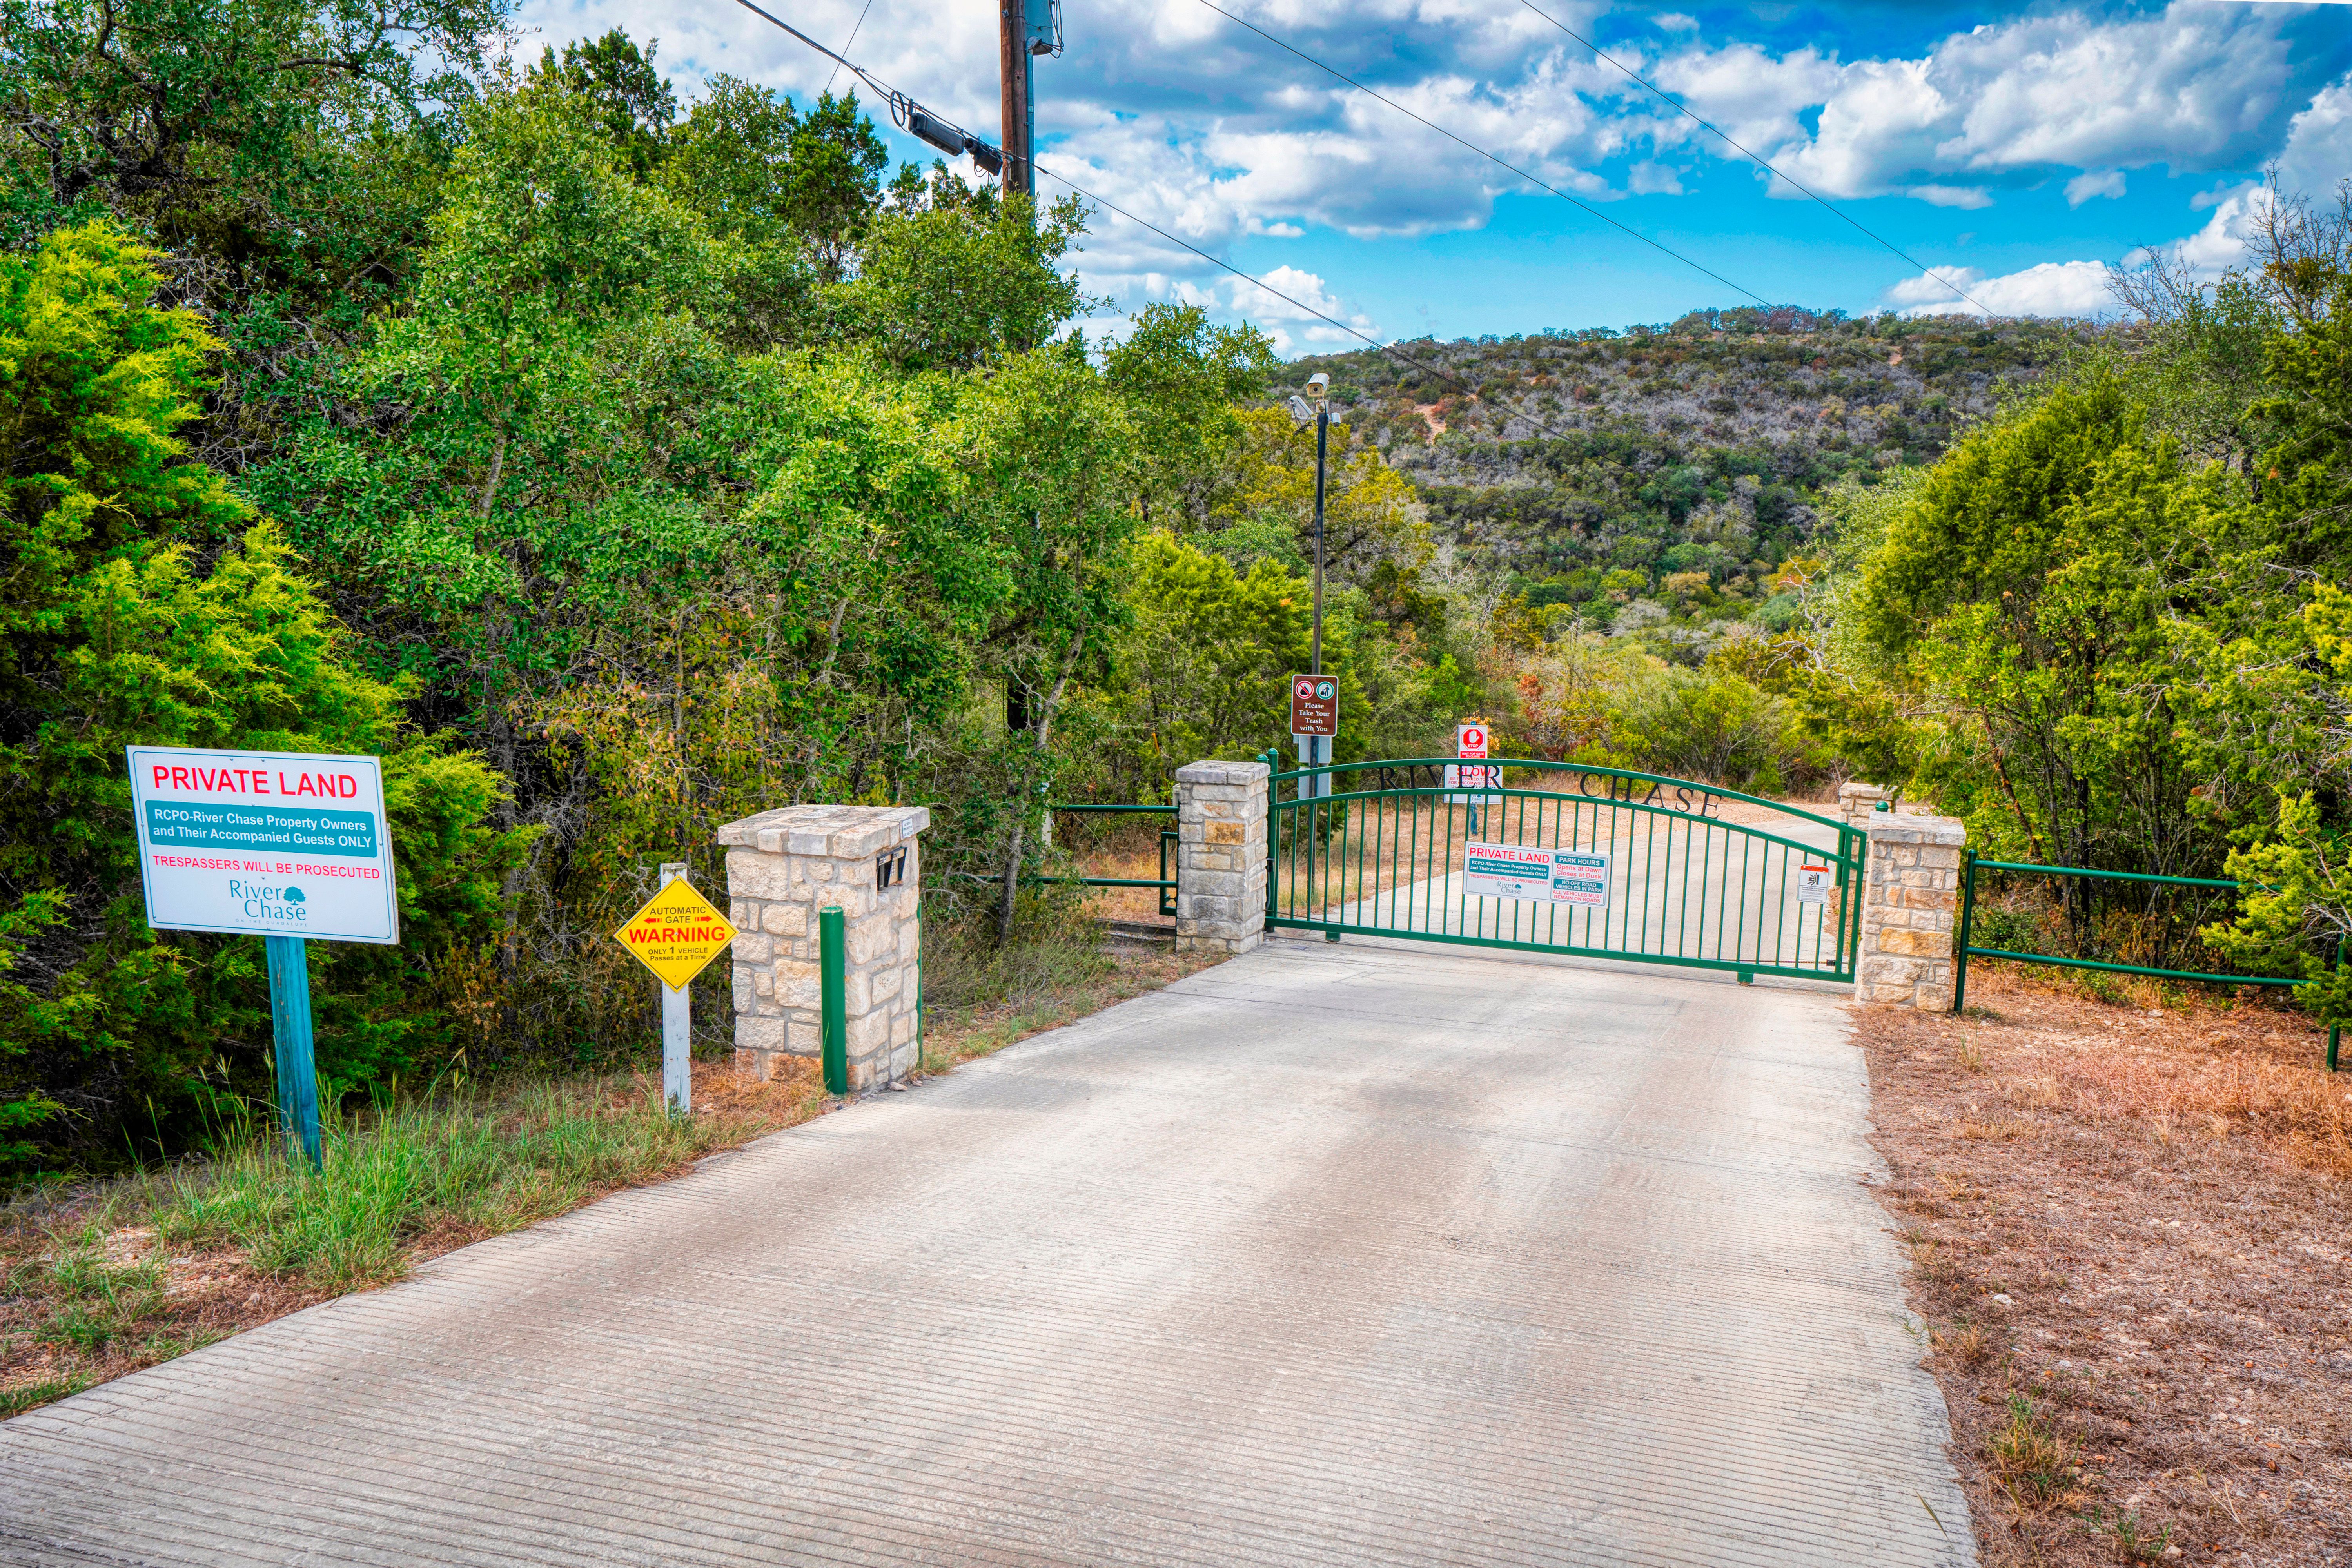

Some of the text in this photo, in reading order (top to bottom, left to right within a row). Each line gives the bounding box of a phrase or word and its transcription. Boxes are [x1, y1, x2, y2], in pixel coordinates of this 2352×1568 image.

[152, 765, 357, 798] PRIVATE LAND
[1457, 767, 1491, 776] SLOW
[1377, 764, 1722, 820] RIVER CHASE
[154, 809, 367, 831] RCPO-River Chase Property Owners
[153, 826, 371, 848] and Their Accompanied Guests ONLY
[1469, 847, 1550, 863] PRIVATE LAND
[153, 855, 380, 879] TRESPASSERS WILL BE PROSECUTED
[229, 880, 281, 900] River
[244, 898, 306, 920] Chase
[650, 906, 706, 915] AUTOMATIC
[629, 926, 725, 944] WARNING
